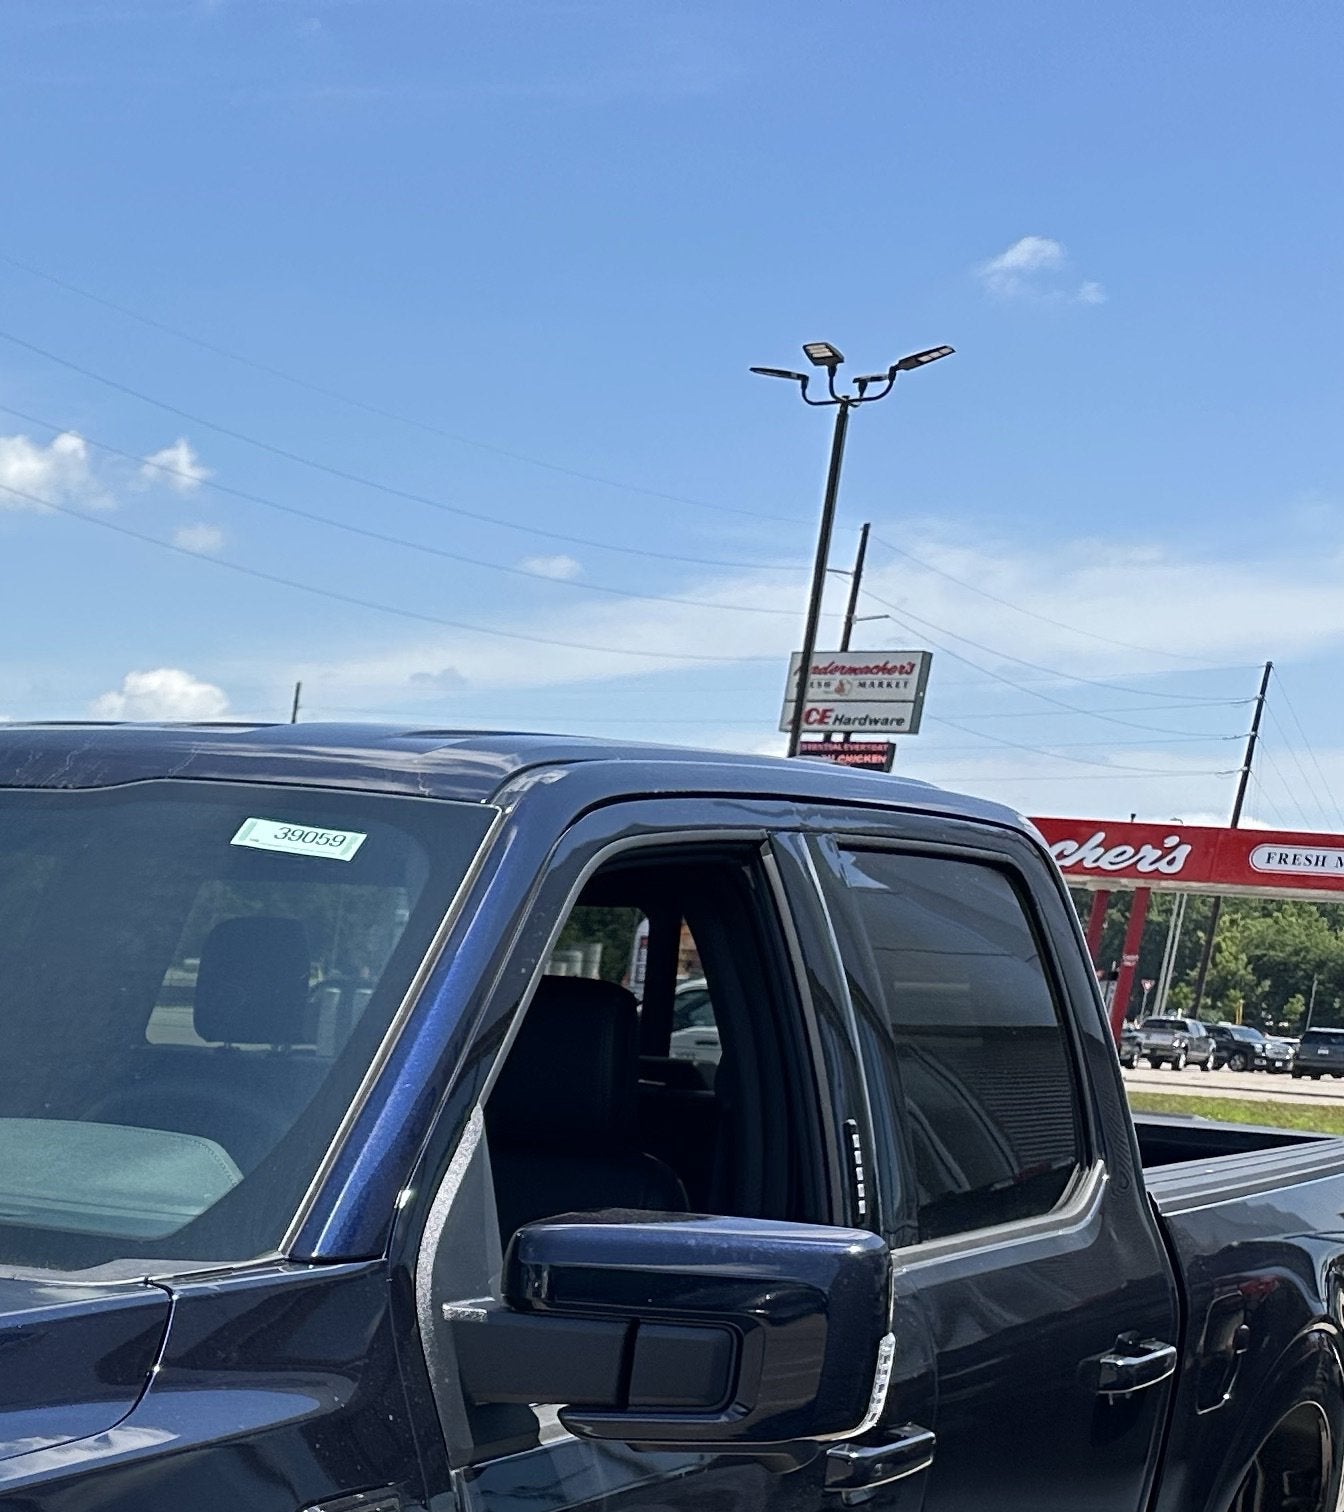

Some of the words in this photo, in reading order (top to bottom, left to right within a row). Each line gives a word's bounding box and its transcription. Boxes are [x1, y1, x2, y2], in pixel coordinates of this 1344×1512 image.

[857, 680, 910, 690] MARKET
[832, 713, 906, 728] Hardware
[273, 826, 348, 848] 39059
[1050, 831, 1193, 875] cher's
[1265, 850, 1329, 868] FRESH
